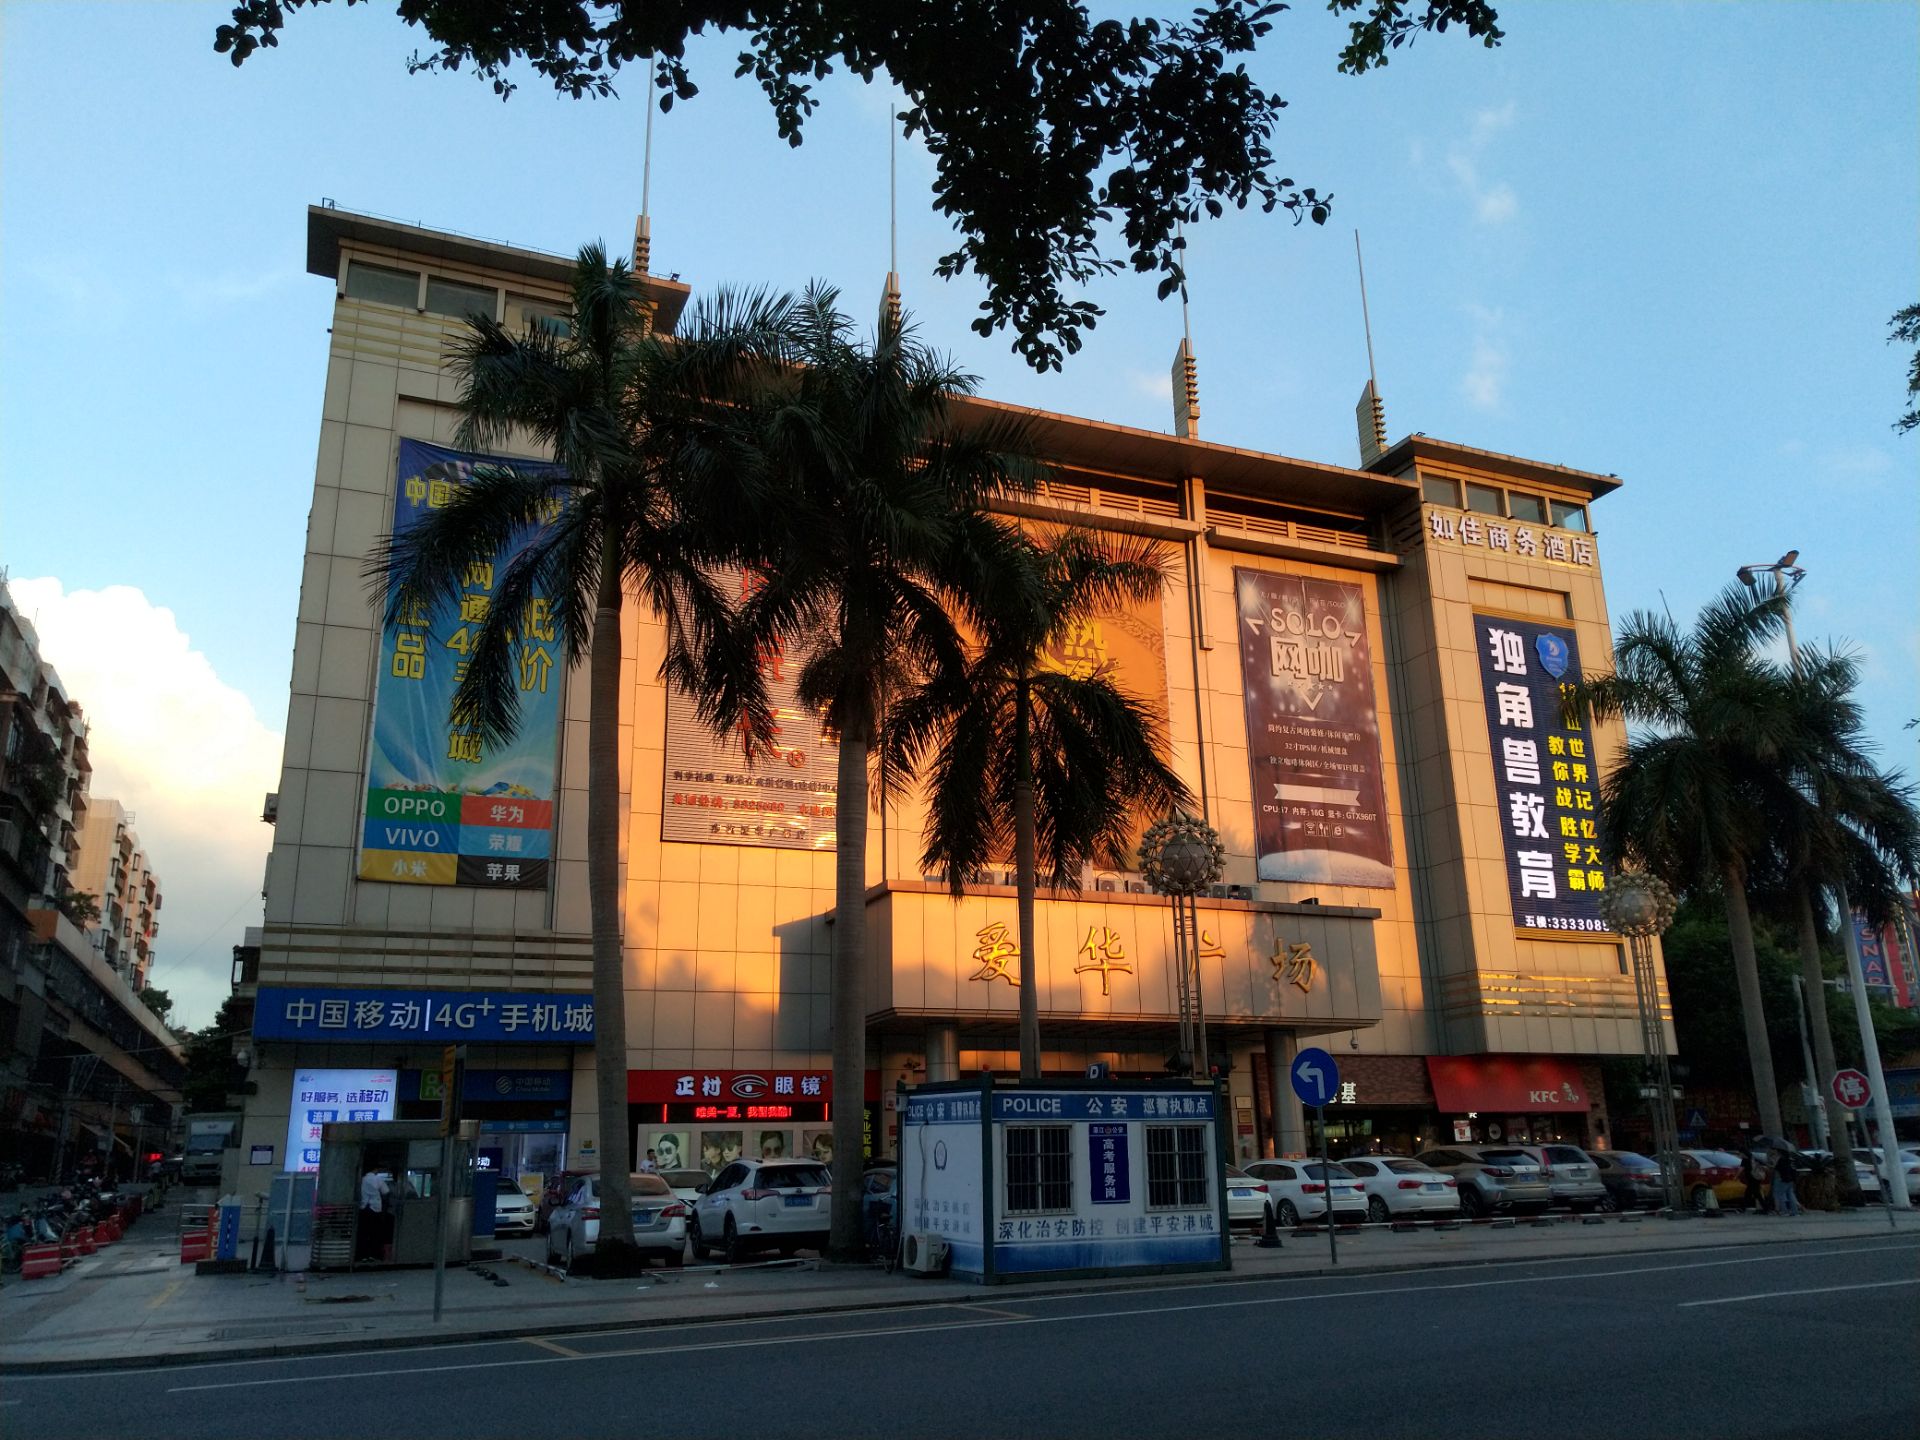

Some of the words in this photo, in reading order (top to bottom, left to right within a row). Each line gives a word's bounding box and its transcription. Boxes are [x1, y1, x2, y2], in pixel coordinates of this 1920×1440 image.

[1429, 511, 1593, 566] 如佳商务酒店
[1270, 636, 1345, 684] 网咖
[1487, 626, 1557, 900] 独角兽教育
[383, 796, 446, 818] OPPO
[489, 803, 525, 825] 华为
[1547, 734, 1587, 892] 教你战胜学霸
[384, 828, 440, 848] VIVO
[488, 834, 523, 853] 荣耀
[391, 858, 428, 878] 小米
[485, 862, 522, 883] 苹果
[775, 1076, 821, 1095] 眼镜
[1530, 1090, 1559, 1103] KFC
[1839, 1075, 1865, 1102] 停
[1003, 1097, 1061, 1113] POLICE
[1085, 1096, 1128, 1115] 公安
[1143, 1097, 1209, 1115] 巡警执勤点
[1102, 1138, 1117, 1199] 高考服务岗
[998, 1218, 1105, 1240] 深化治安防控
[1116, 1213, 1214, 1236] 创建平安港城
